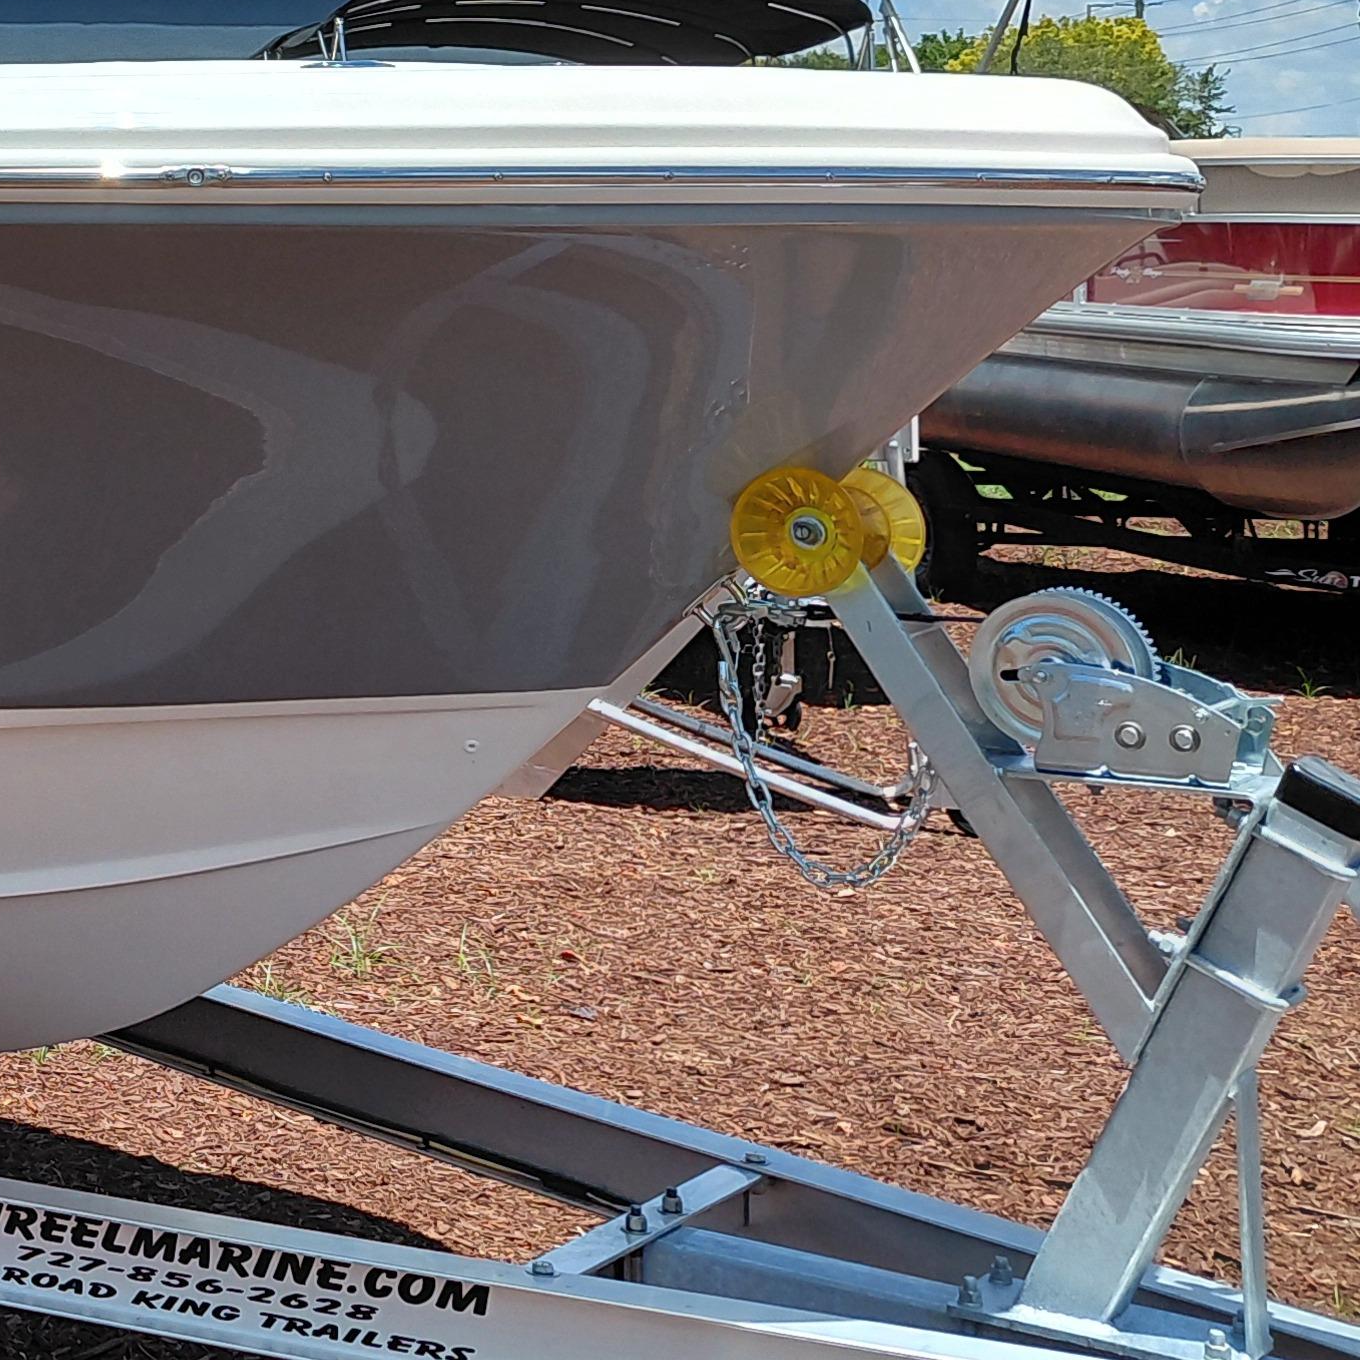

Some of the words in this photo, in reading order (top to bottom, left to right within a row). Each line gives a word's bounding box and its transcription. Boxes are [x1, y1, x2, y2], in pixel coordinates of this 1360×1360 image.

[0, 1265, 118, 1299] ROAD
[130, 1289, 241, 1321] KING
[258, 1311, 476, 1360] TRAILERS
[16, 1244, 381, 1321] 727-856-2628
